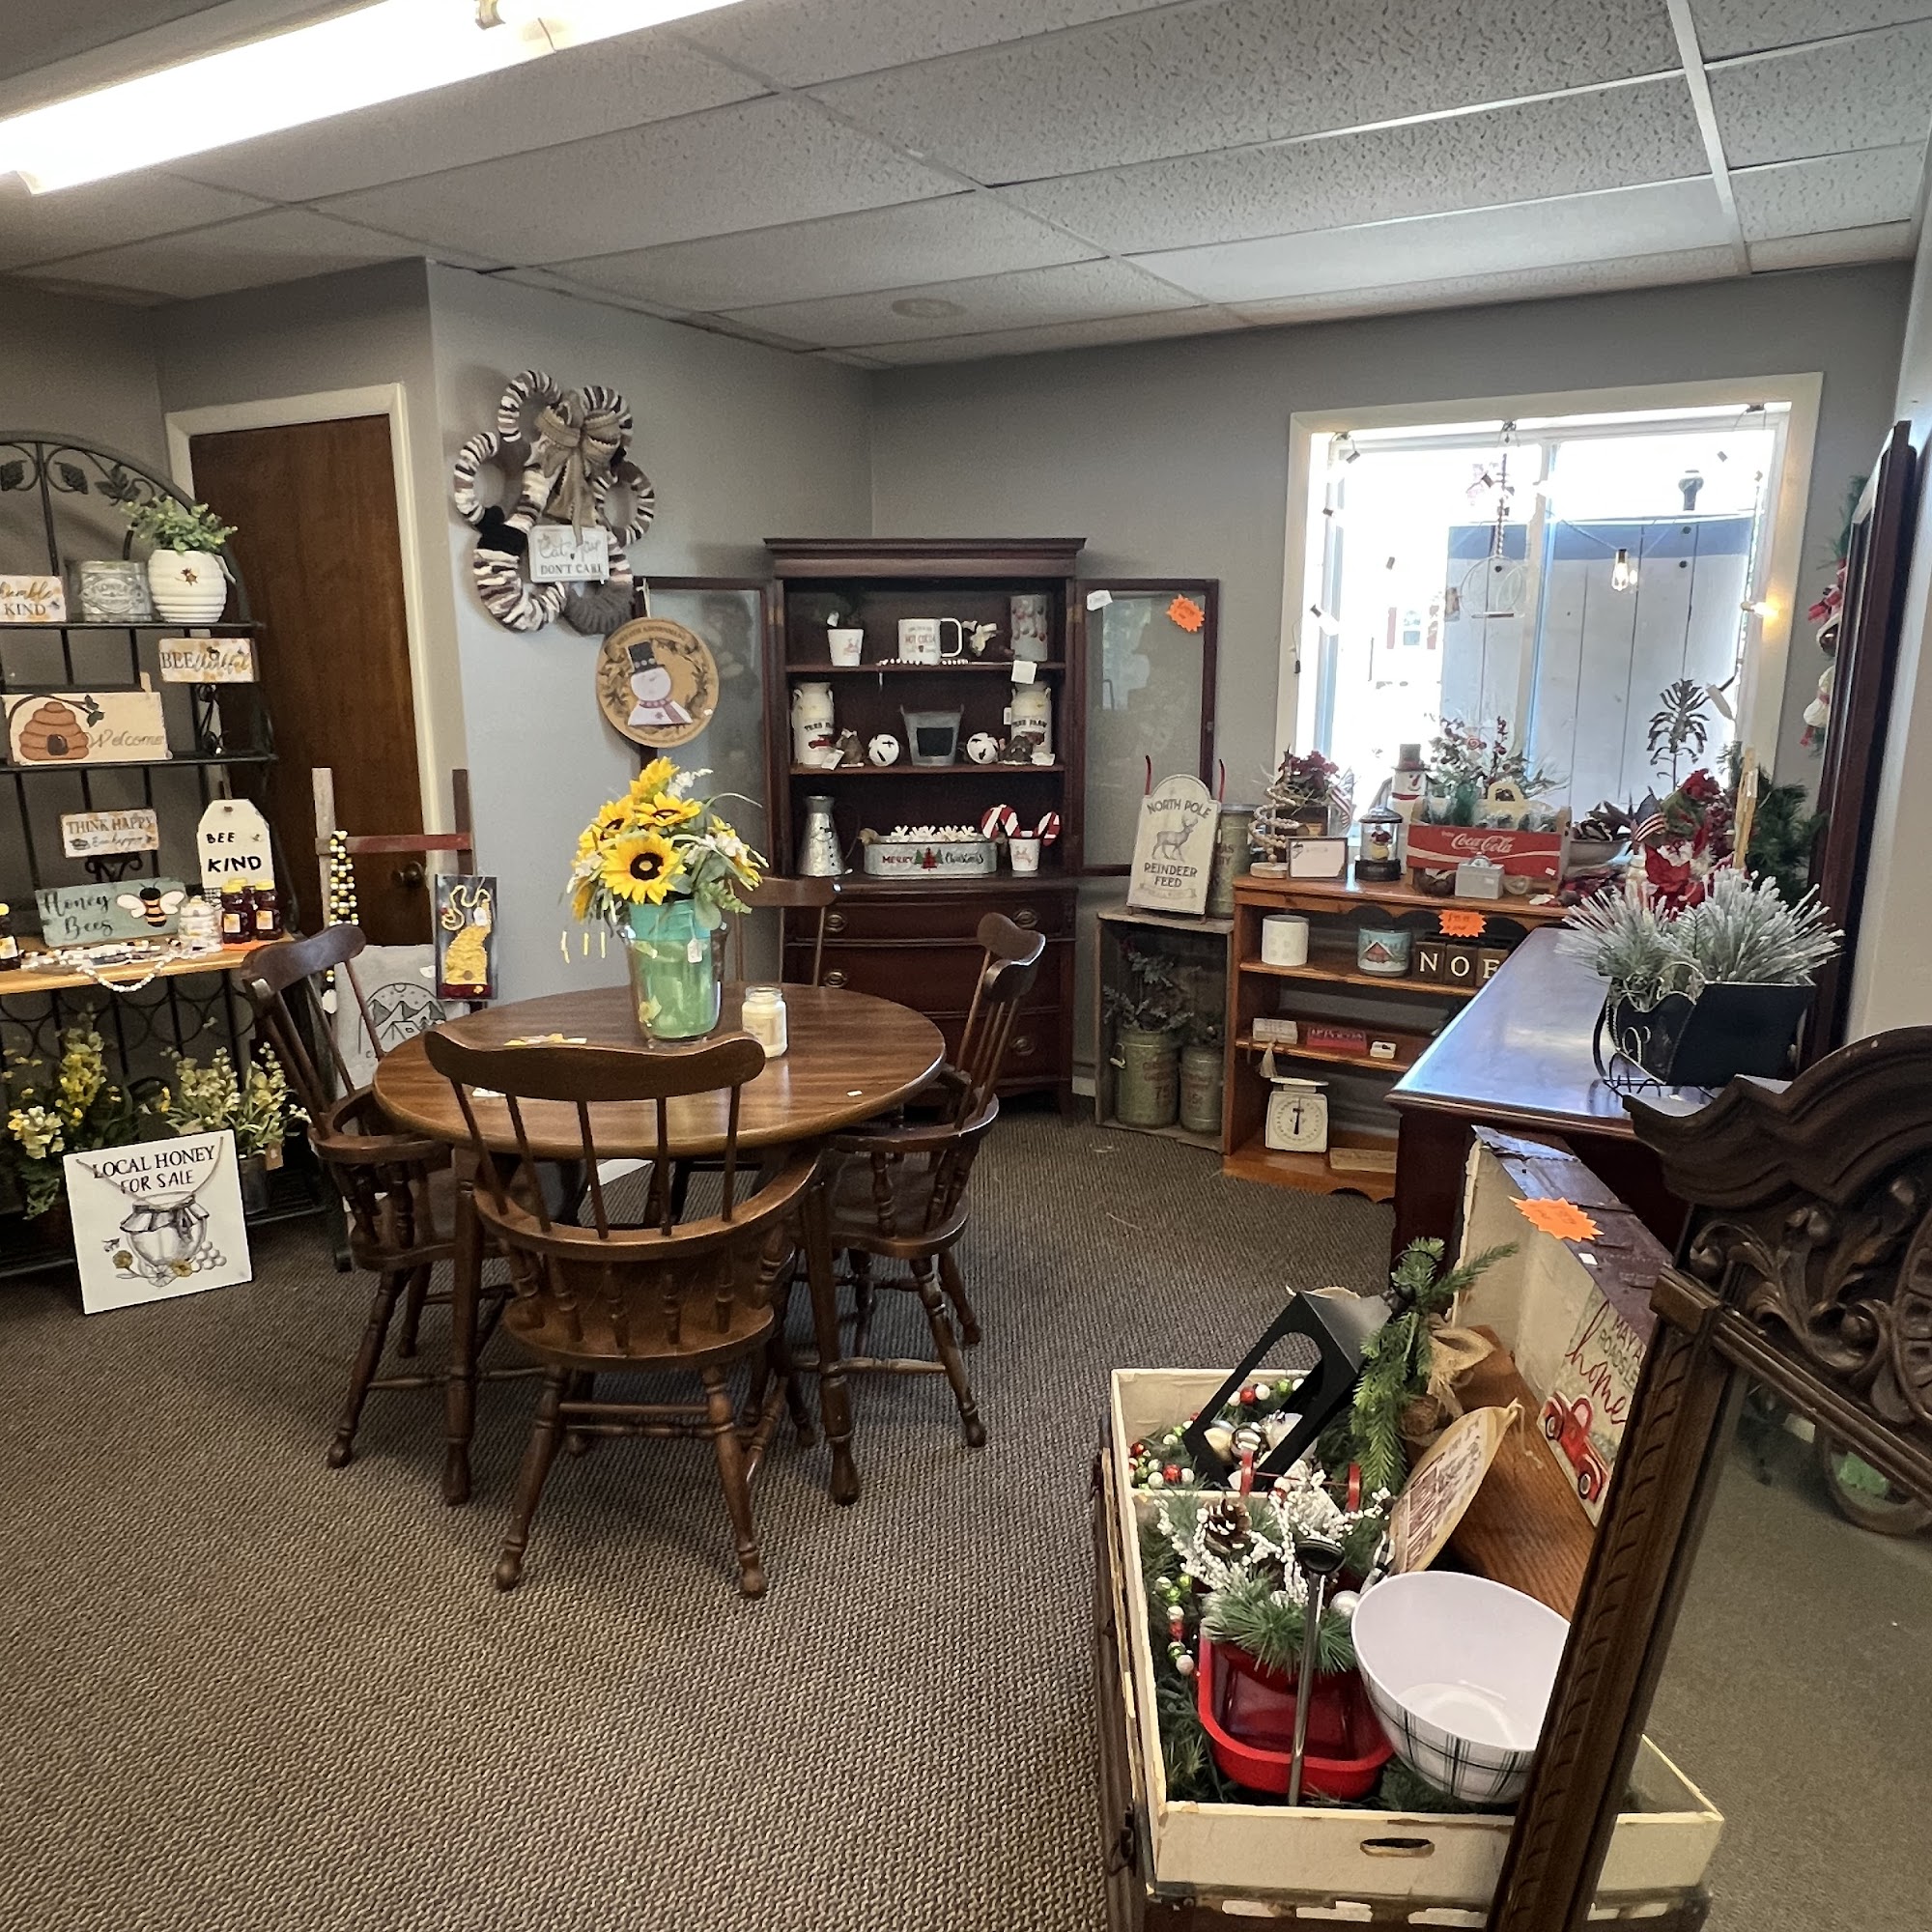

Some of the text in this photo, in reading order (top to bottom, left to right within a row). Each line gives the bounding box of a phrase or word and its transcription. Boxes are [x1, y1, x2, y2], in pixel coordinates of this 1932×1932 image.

[4, 603, 46, 616] KIND
[159, 651, 194, 669] BEE
[84, 728, 164, 749] Welcome
[1147, 798, 1212, 819] NORTH POLE
[66, 815, 154, 835] THINK HAPPY
[206, 832, 236, 844] BEE
[208, 855, 262, 873] KIND
[1144, 862, 1198, 878] REINDEER
[1154, 875, 1182, 888] FEED
[40, 890, 111, 917] Honey
[63, 915, 114, 941] Bees
[1419, 951, 1501, 980] NOE
[93, 1145, 215, 1179] LOCAL HONEY
[121, 1170, 195, 1194] FOR SALE
[1611, 1314, 1638, 1352] MAY
[1565, 1298, 1628, 1426] home
